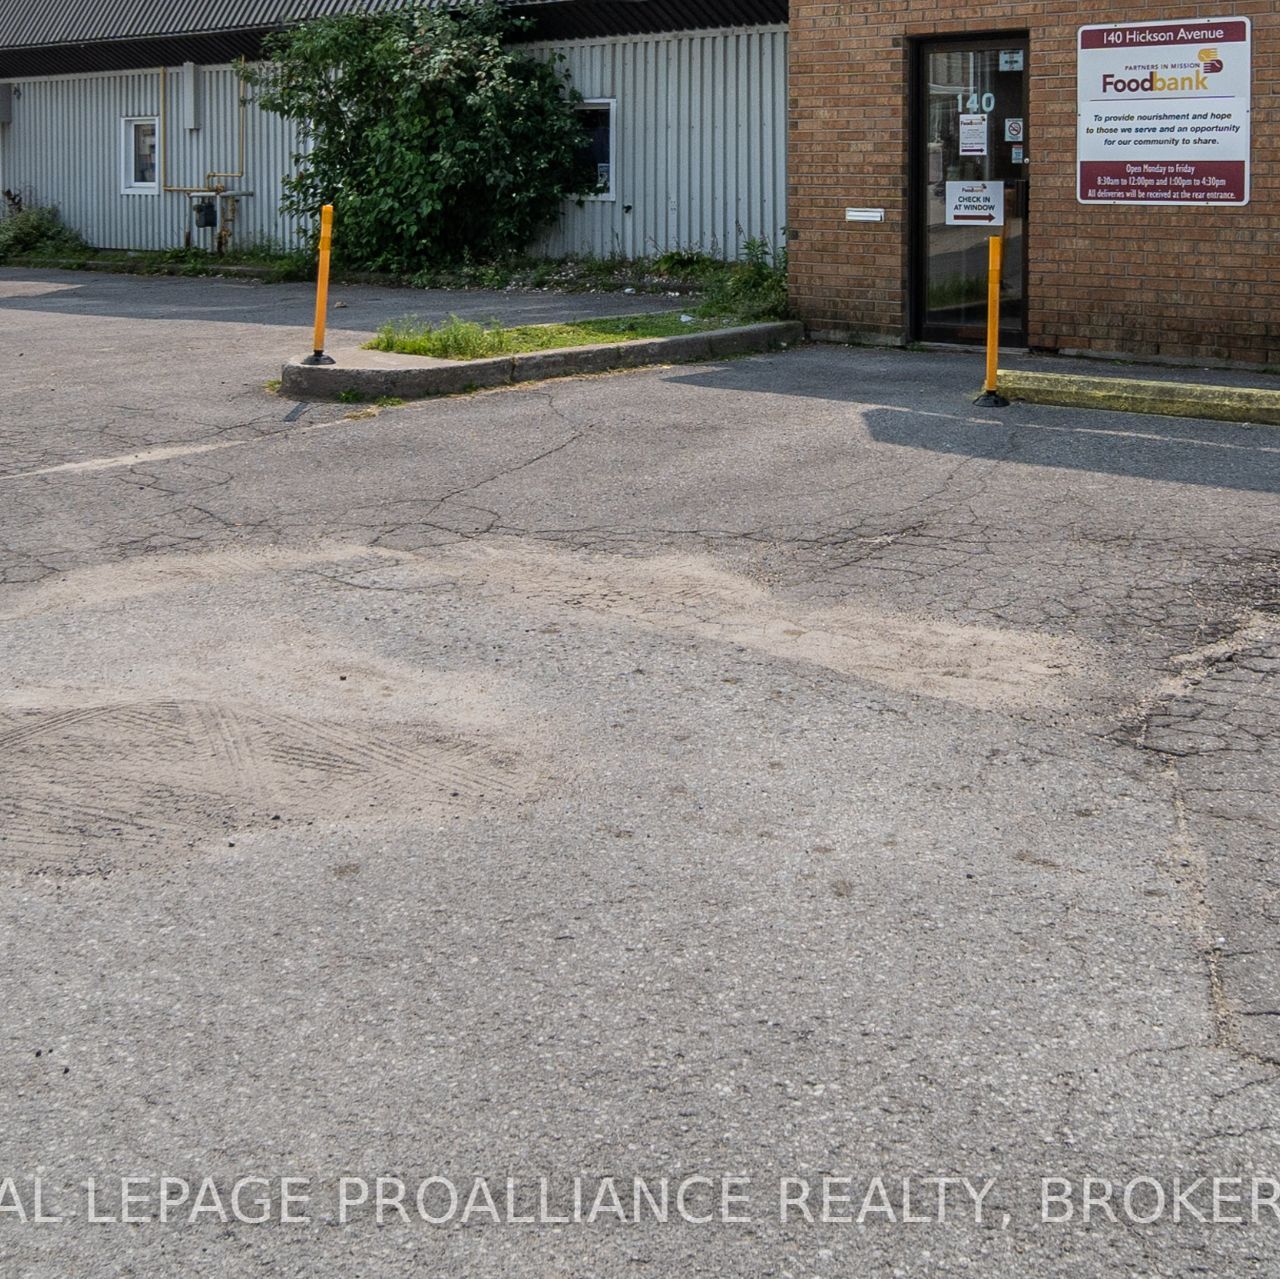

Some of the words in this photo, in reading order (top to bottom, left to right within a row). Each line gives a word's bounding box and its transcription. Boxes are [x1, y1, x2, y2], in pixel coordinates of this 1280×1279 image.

[1103, 32, 1122, 44] 140
[1126, 30, 1174, 43] Hickson
[1177, 28, 1224, 40] Avenue
[1103, 69, 1208, 92] Foodbank
[957, 93, 995, 112] 140
[1104, 114, 1135, 123] provide
[1137, 113, 1189, 121] nourishment
[1192, 112, 1208, 120] and
[1210, 112, 1232, 120] hope
[1190, 124, 1240, 133] opportunity
[1134, 138, 1179, 146] community
[1126, 164, 1141, 175] Open
[1143, 164, 1167, 175] Monday
[1176, 164, 1195, 175] Friday
[1097, 176, 1120, 185] 8:30am
[1129, 176, 1155, 188] 12:00pm
[1156, 177, 1168, 185] and
[1170, 177, 1192, 188] 1:00pm
[1201, 177, 1226, 188] 4:30pm
[1088, 189, 1096, 197] All
[1097, 189, 1124, 198] deliveries
[1126, 189, 1136, 197] will
[1138, 189, 1145, 198] be
[1147, 189, 1171, 198] received
[1180, 190, 1191, 198] the
